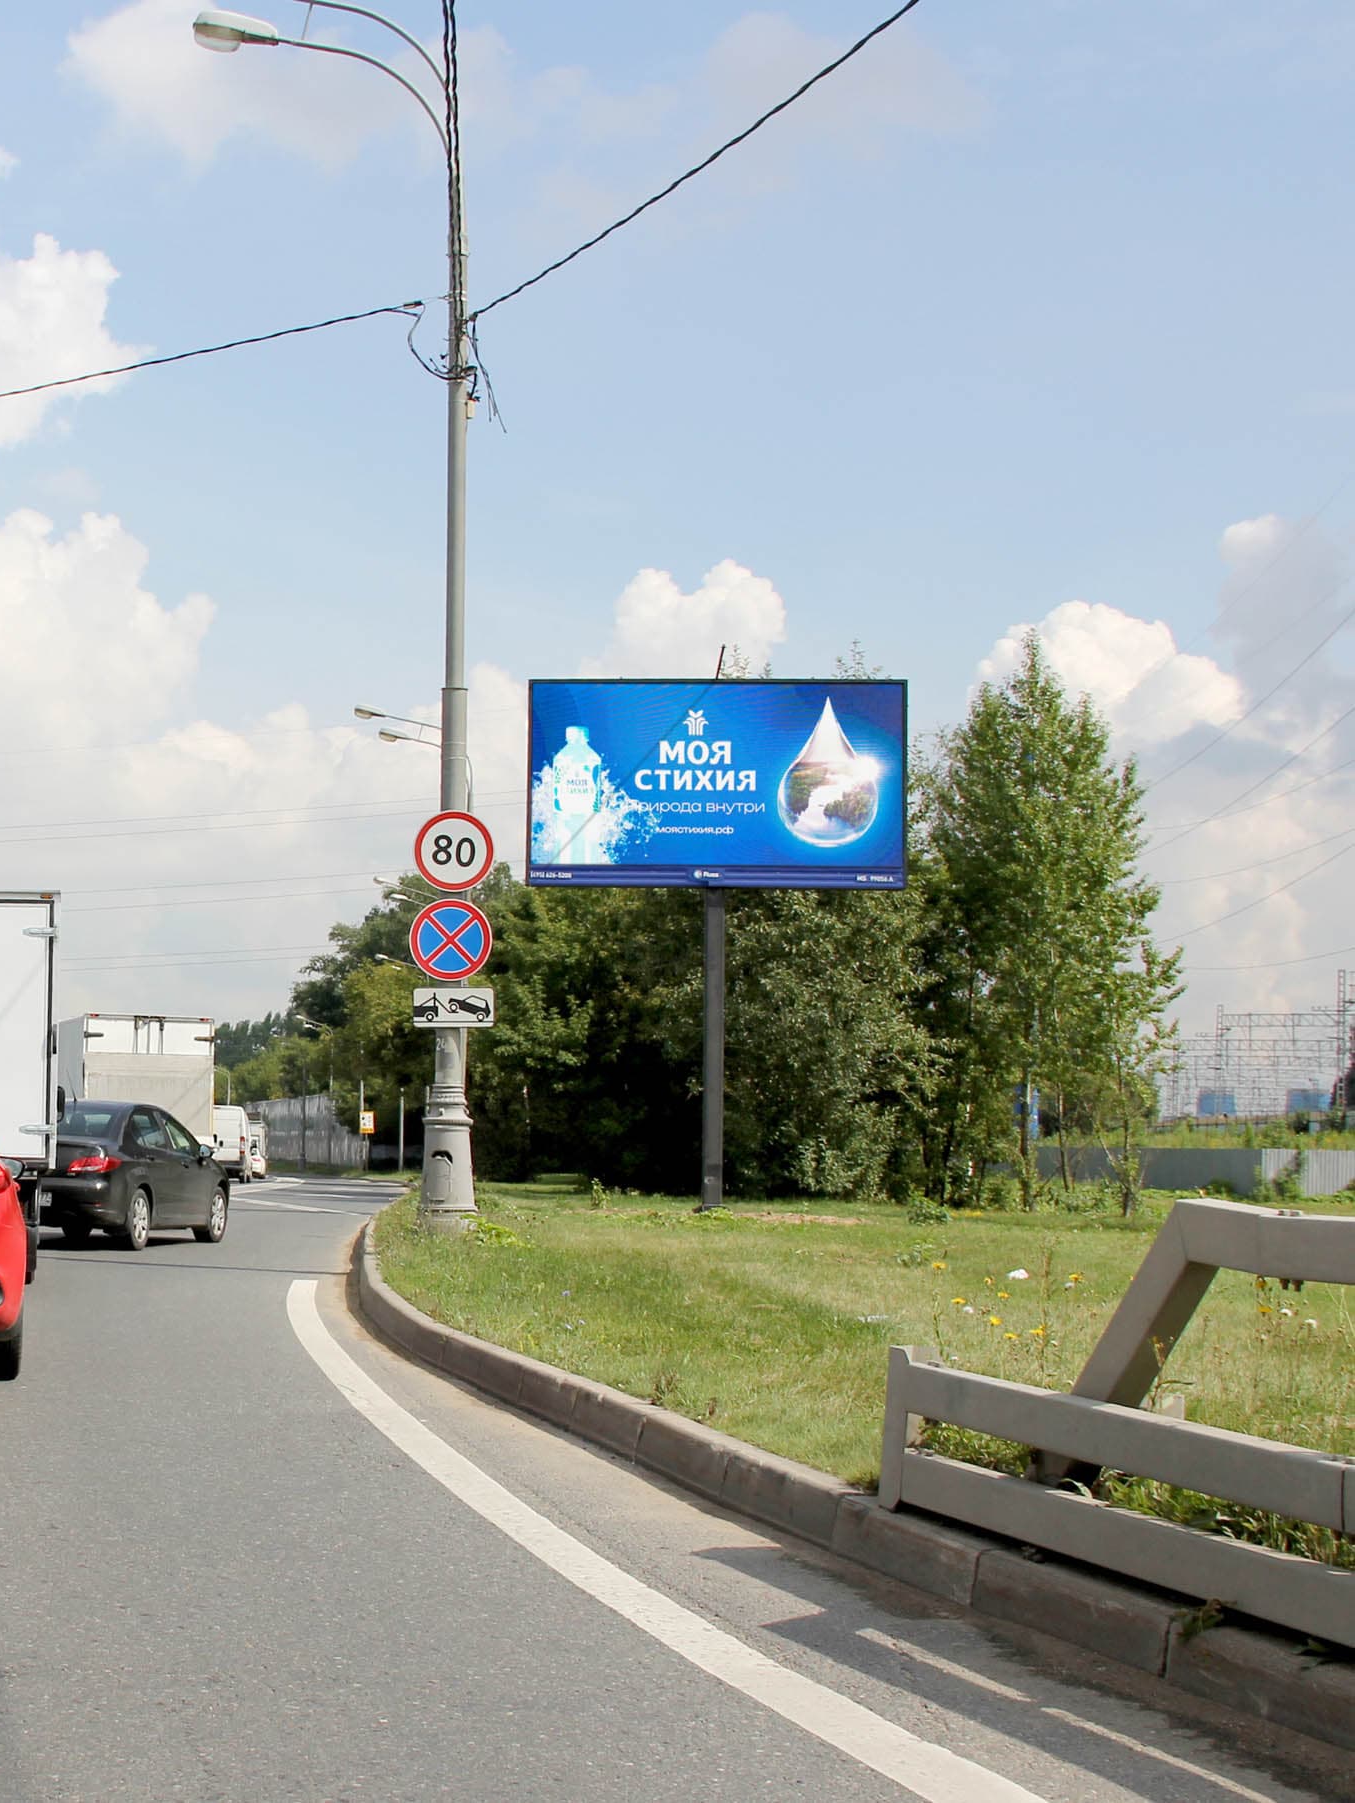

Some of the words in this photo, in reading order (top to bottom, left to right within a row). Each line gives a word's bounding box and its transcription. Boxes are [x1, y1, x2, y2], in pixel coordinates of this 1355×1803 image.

[658, 740, 732, 765] МОЯ
[634, 768, 757, 792] СТИХИЯ
[705, 801, 766, 815] внутри
[656, 825, 735, 836] моястихия.рф
[431, 834, 476, 868] 80
